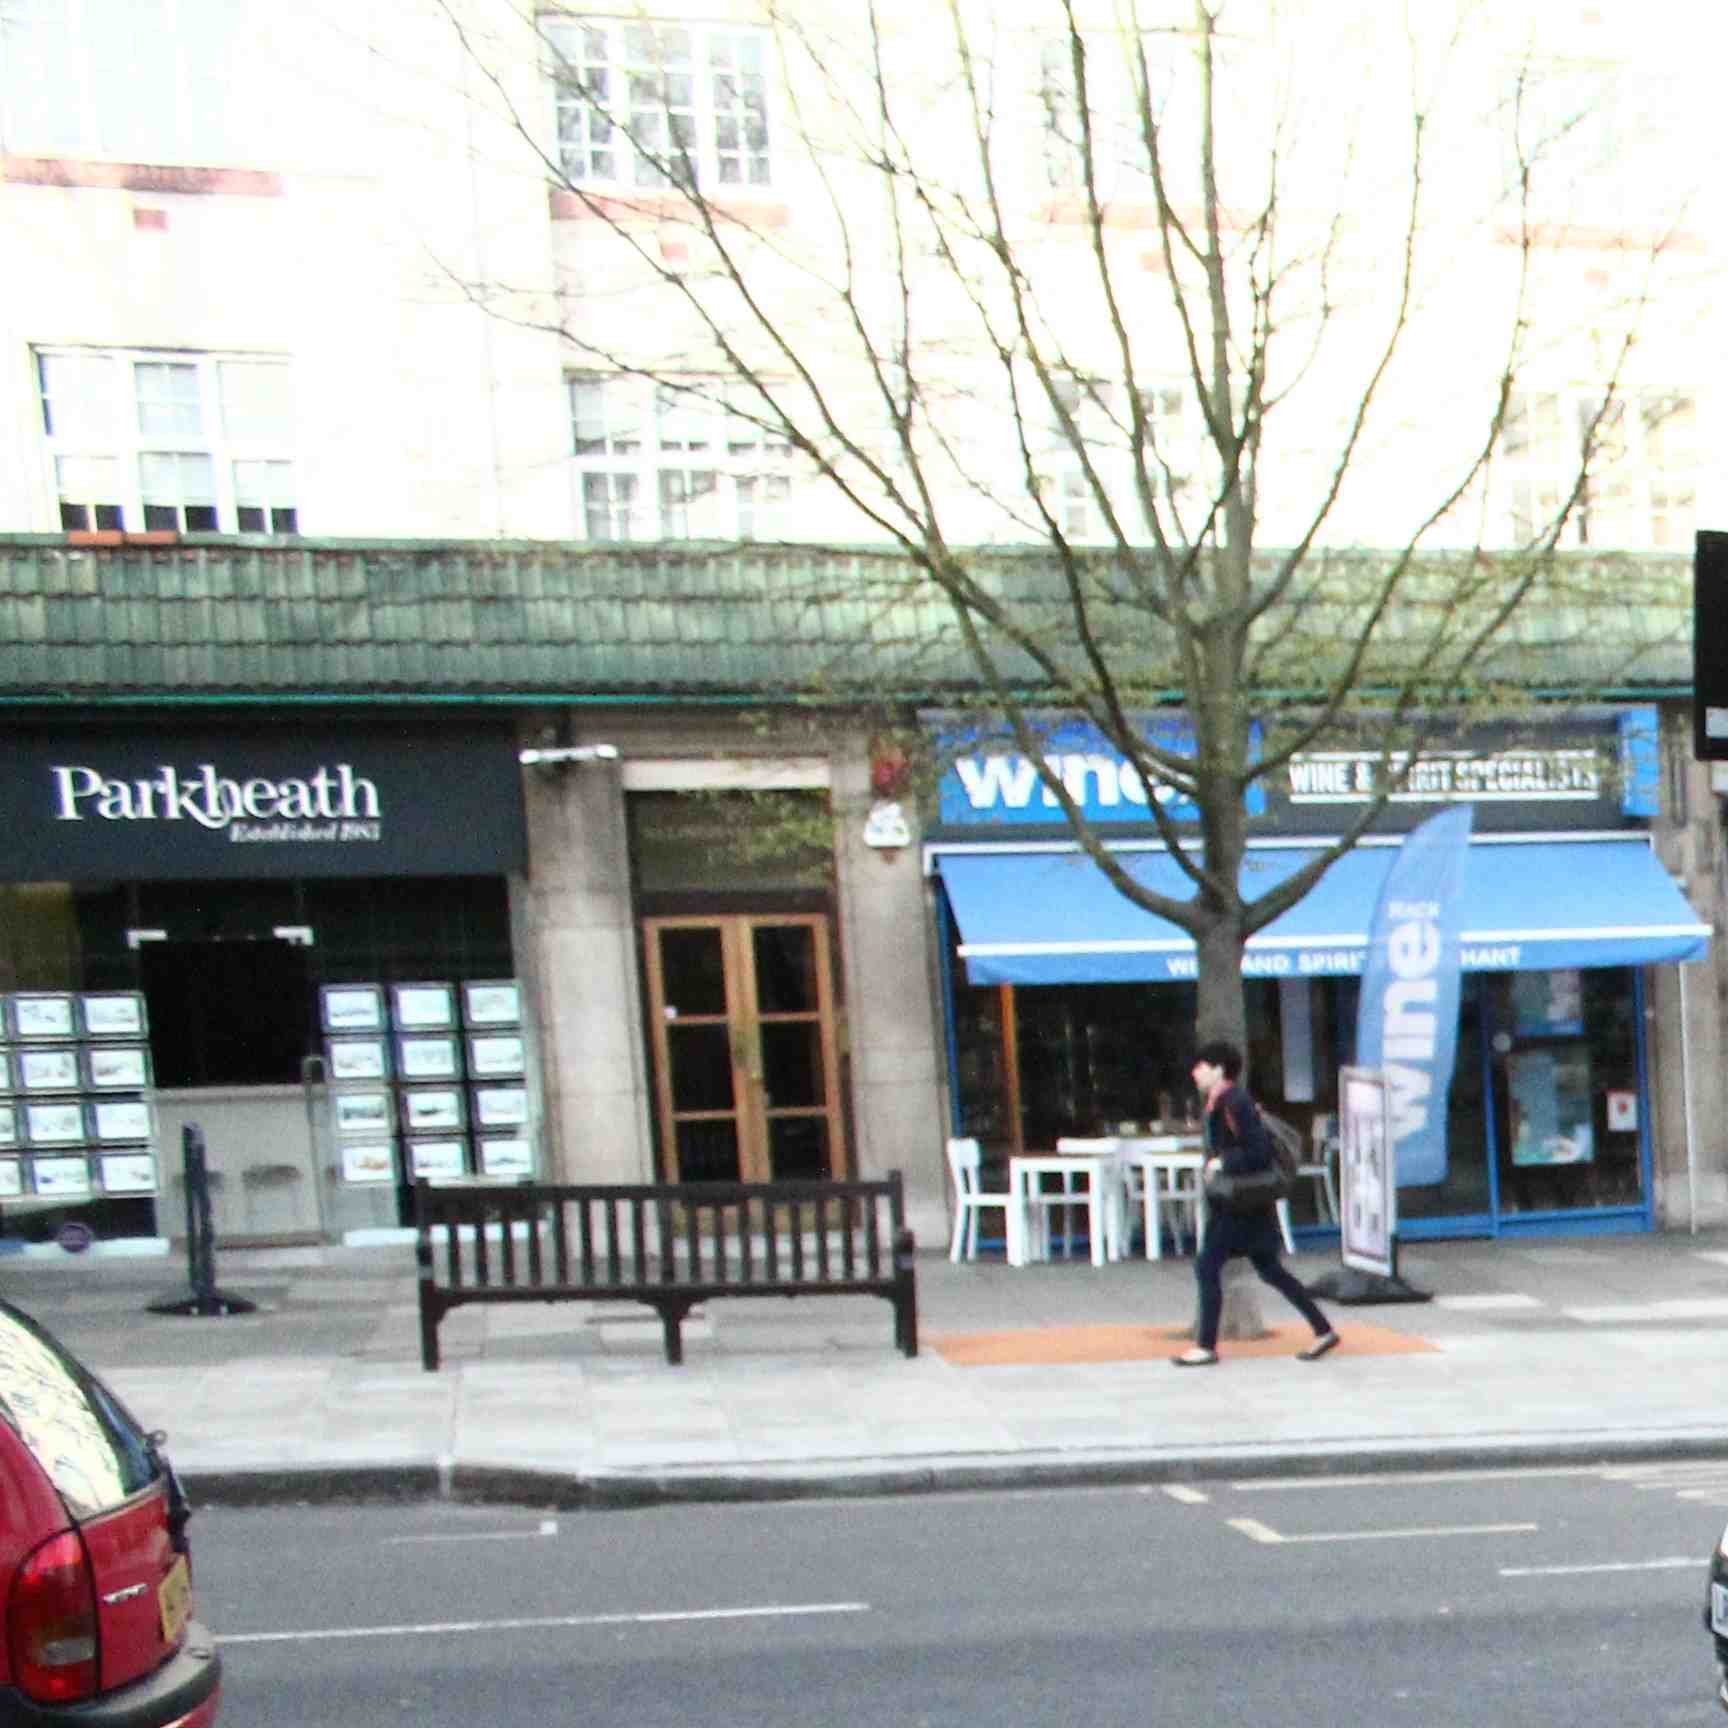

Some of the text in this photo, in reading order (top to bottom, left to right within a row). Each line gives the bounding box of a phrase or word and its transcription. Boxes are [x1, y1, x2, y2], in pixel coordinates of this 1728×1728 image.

[1289, 759, 1350, 794] WINE
[49, 762, 384, 829] Parkheath
[1298, 949, 1369, 973] SPIRI
